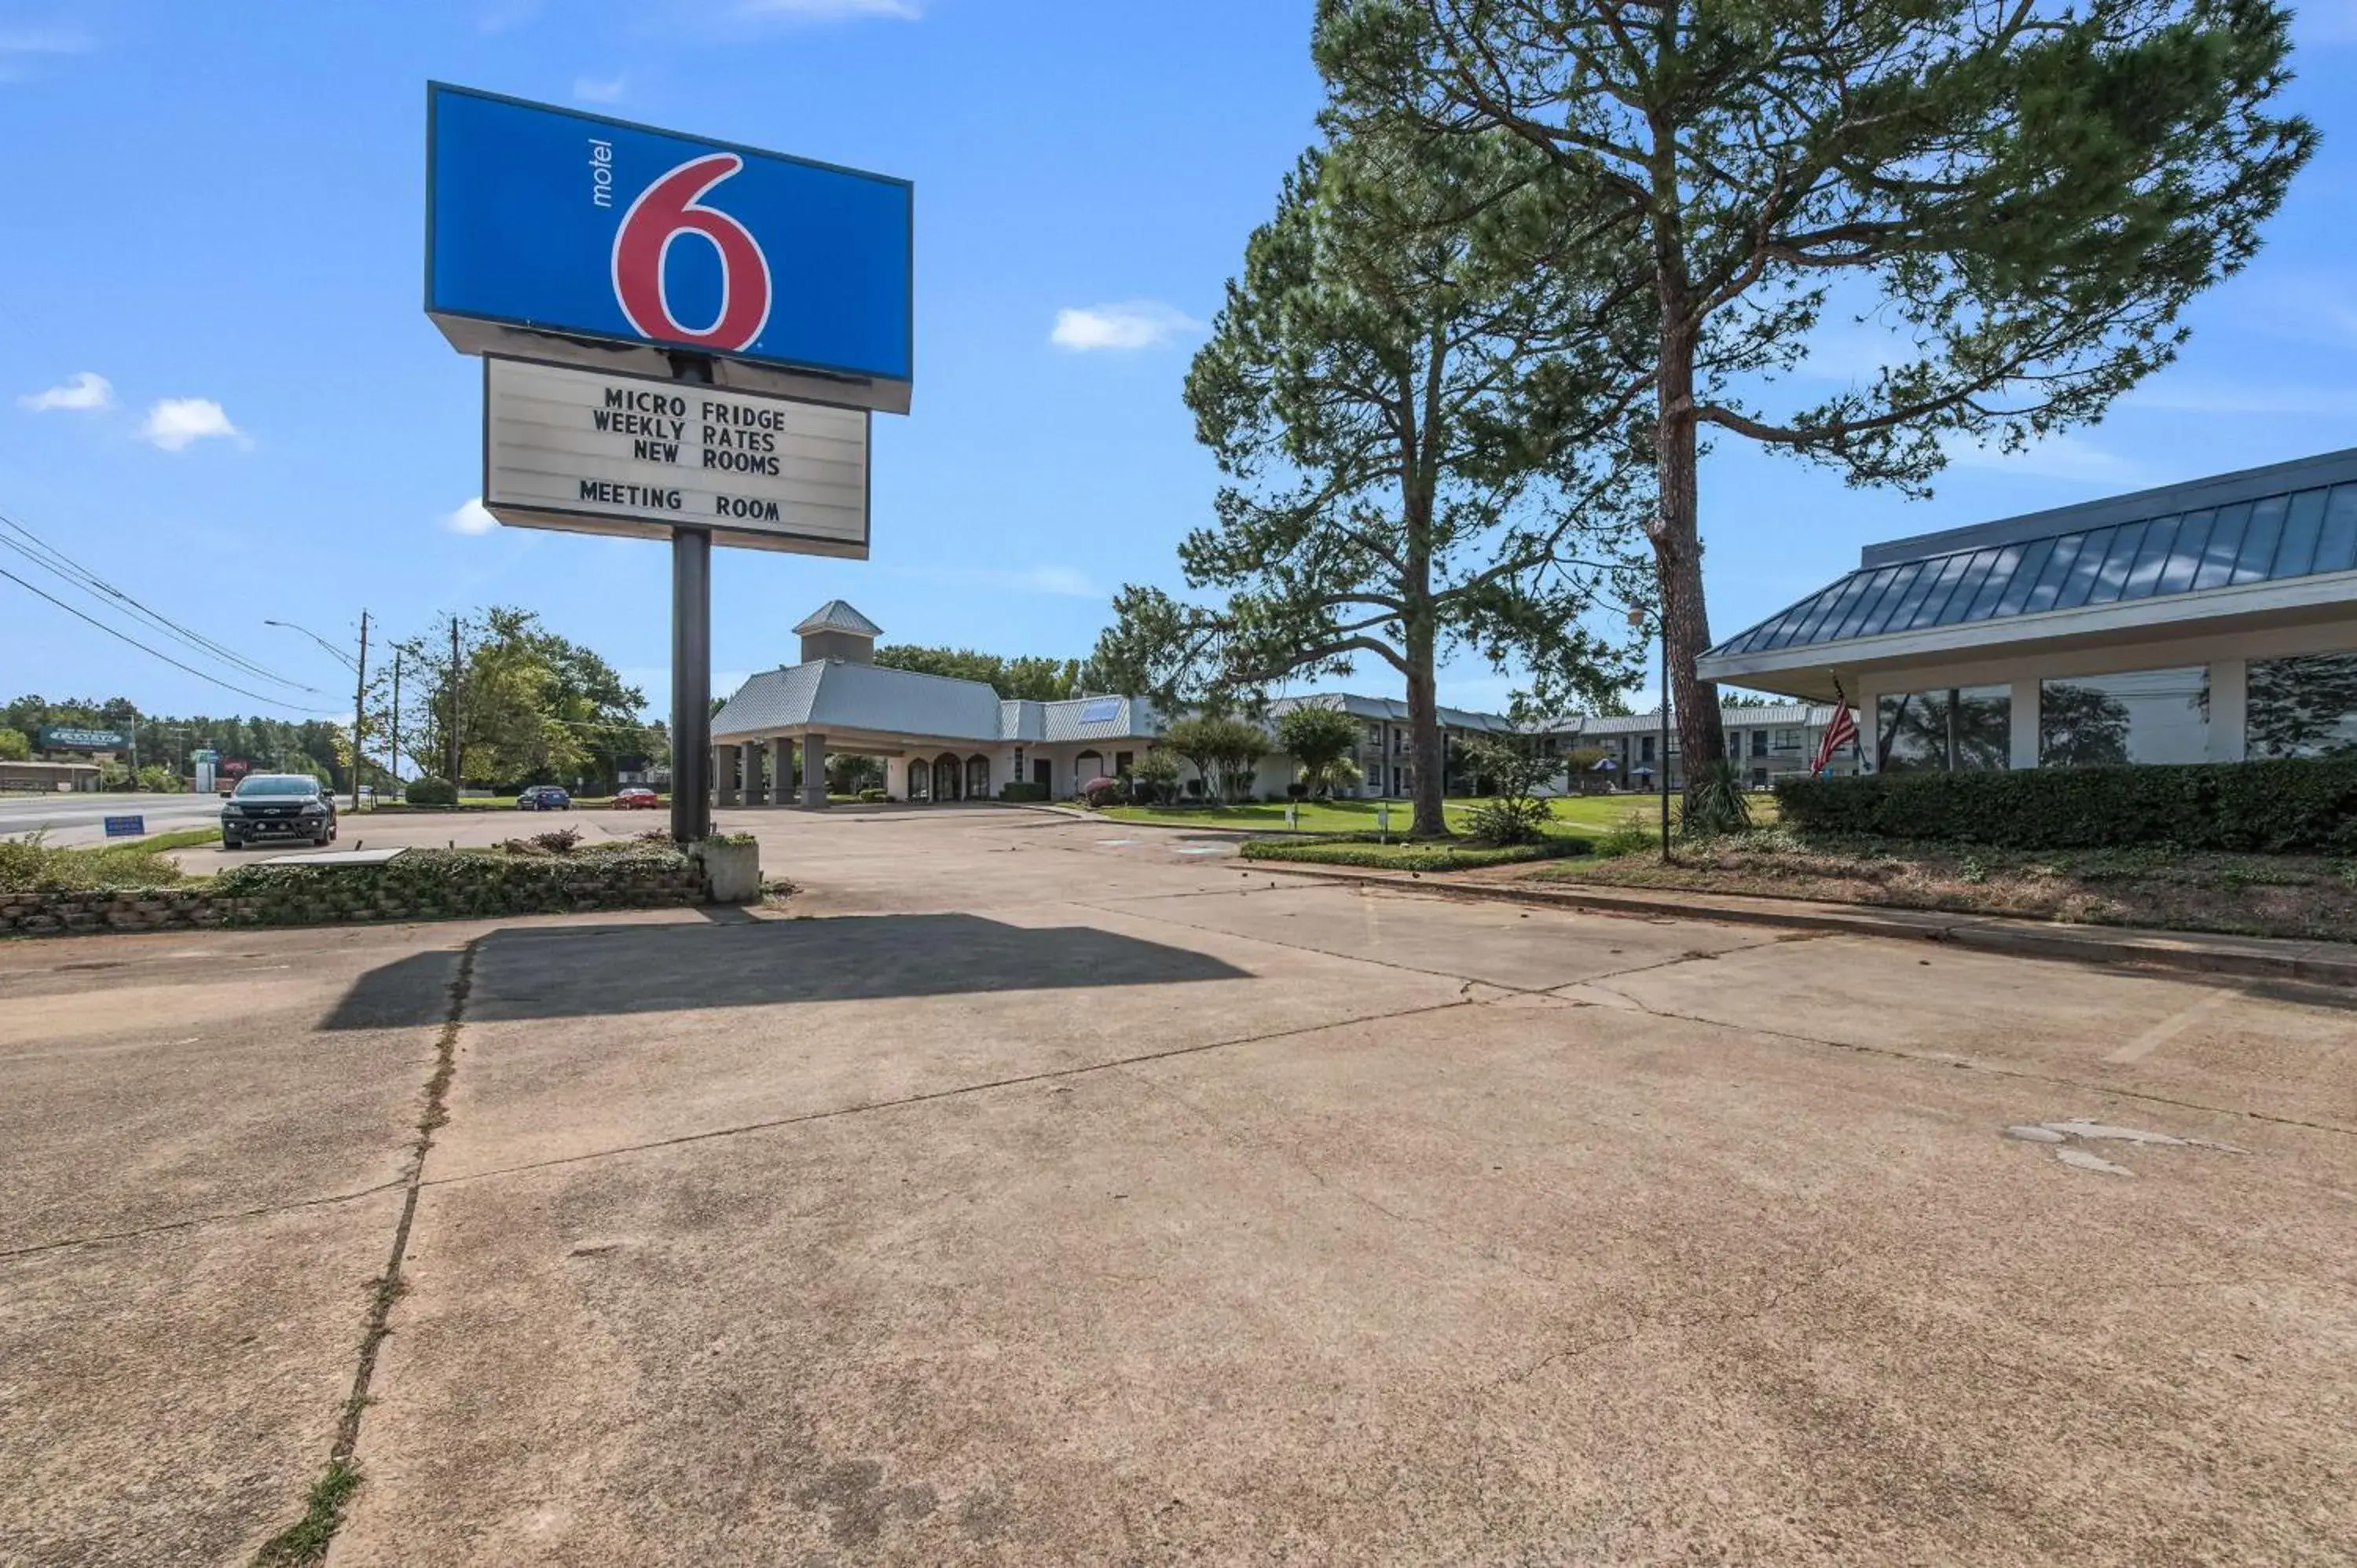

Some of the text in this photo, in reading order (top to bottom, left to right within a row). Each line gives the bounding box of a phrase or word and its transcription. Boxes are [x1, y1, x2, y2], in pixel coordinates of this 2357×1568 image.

[588, 138, 612, 207] motel
[611, 152, 772, 352] 6
[605, 388, 785, 431] MICRO FRIDGE
[594, 410, 775, 452] WEEKLY RATES
[634, 439, 780, 476] NEW ROOMS
[580, 480, 779, 521] MEETING ROOM
